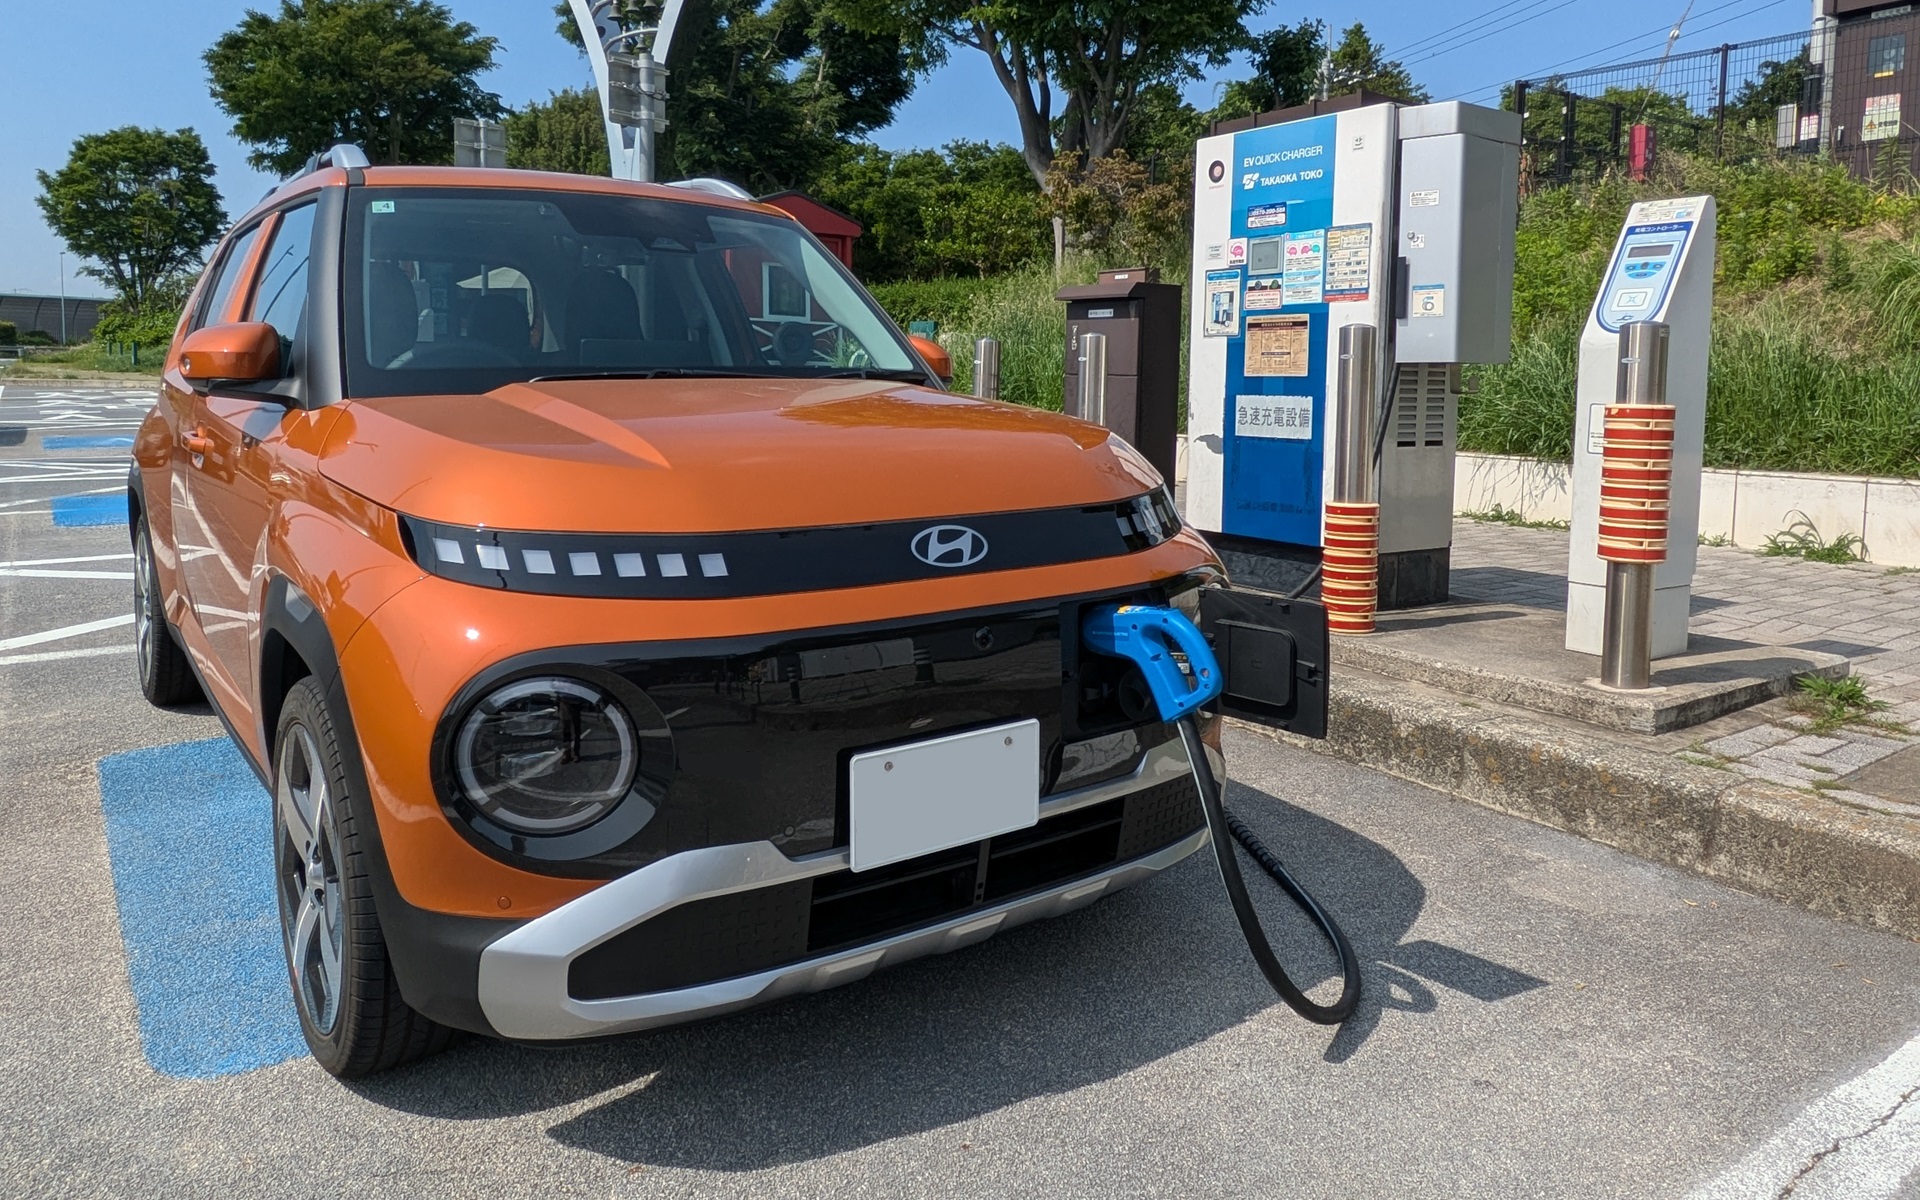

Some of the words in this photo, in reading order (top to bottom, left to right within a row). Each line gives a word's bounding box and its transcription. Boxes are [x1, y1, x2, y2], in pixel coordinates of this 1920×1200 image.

[1244, 157, 1254, 168] EV
[1254, 152, 1281, 166] QUICK
[1281, 145, 1323, 162] CHARGER
[1260, 173, 1298, 187] TAKAOKA
[1300, 169, 1323, 181] TOKO
[1238, 405, 1311, 428] 急速充電設備
